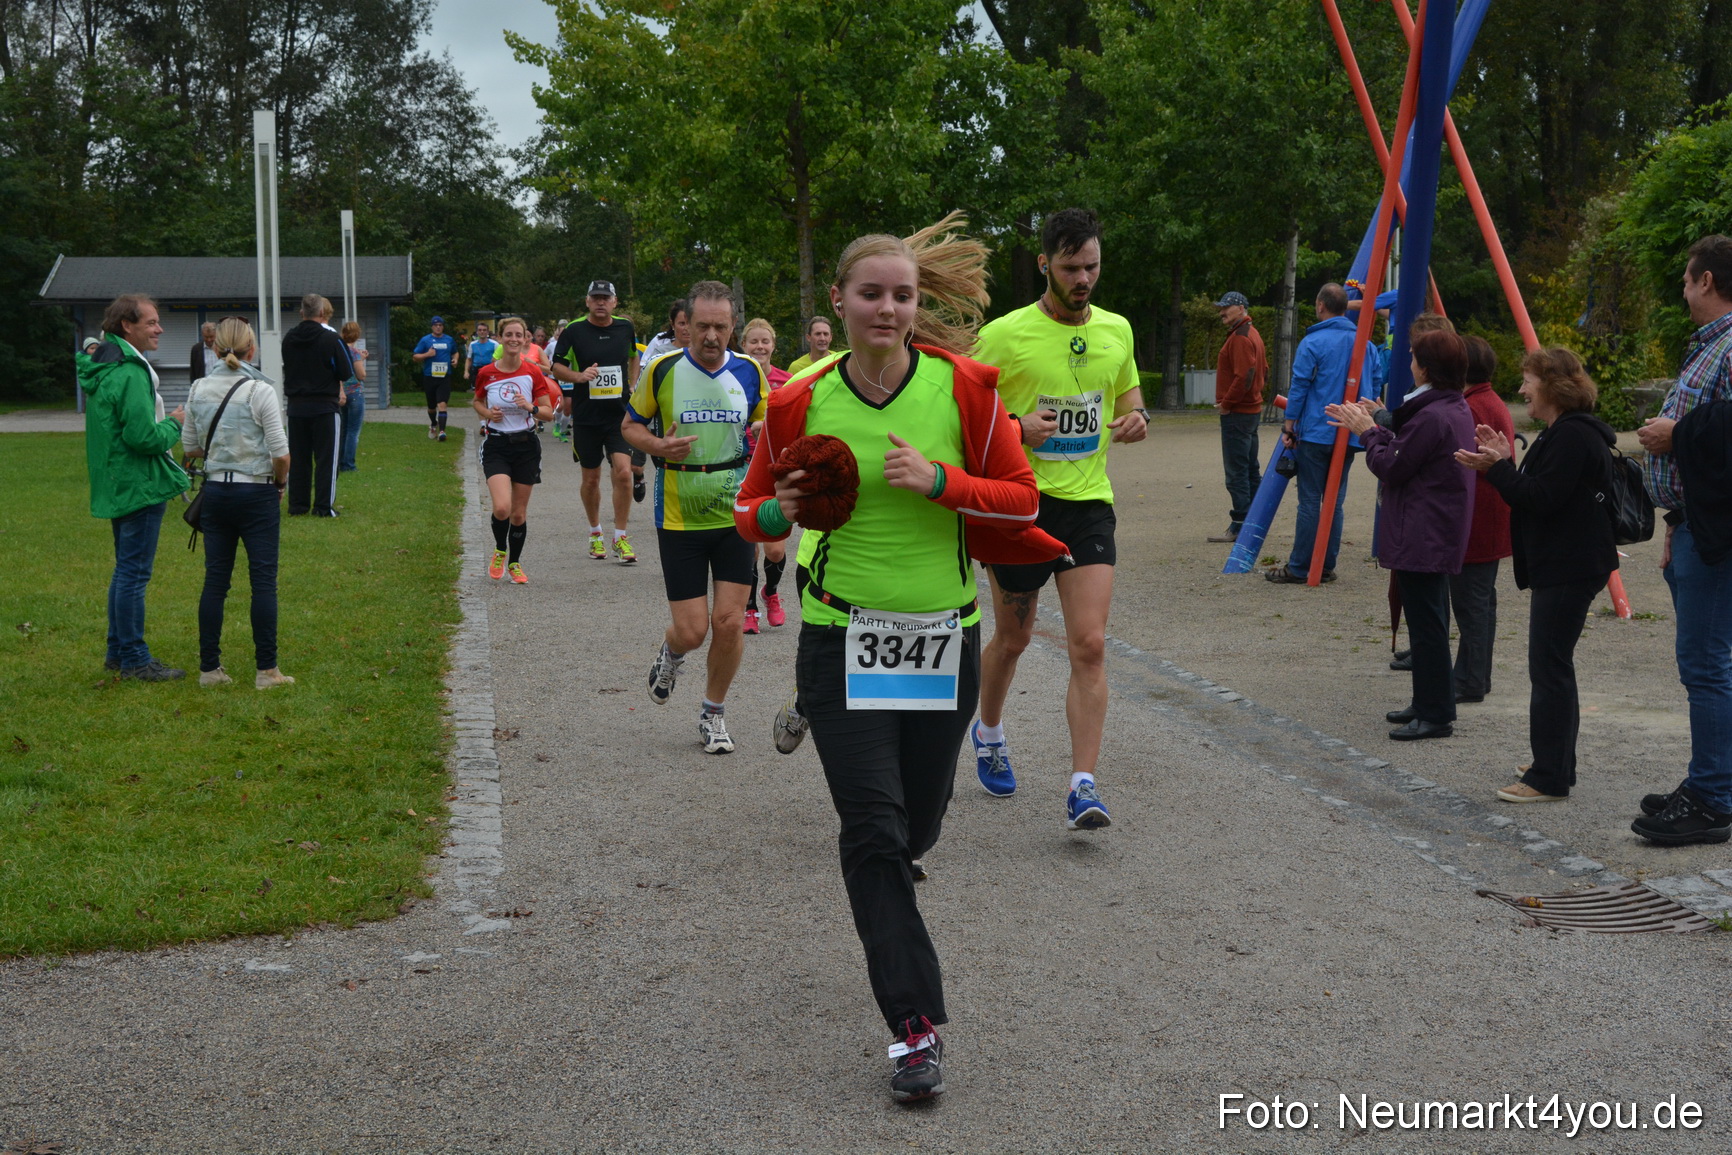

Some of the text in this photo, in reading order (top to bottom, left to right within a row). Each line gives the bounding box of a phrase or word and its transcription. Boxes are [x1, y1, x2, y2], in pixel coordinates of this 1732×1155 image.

[595, 374, 617, 387] 296
[683, 399, 722, 409] TEAM
[1038, 398, 1064, 406] PARTL
[681, 409, 742, 424] BOCK
[1053, 440, 1086, 452] Patrick
[851, 615, 942, 631] PARTL Neumarkt
[857, 632, 951, 670] 3347
